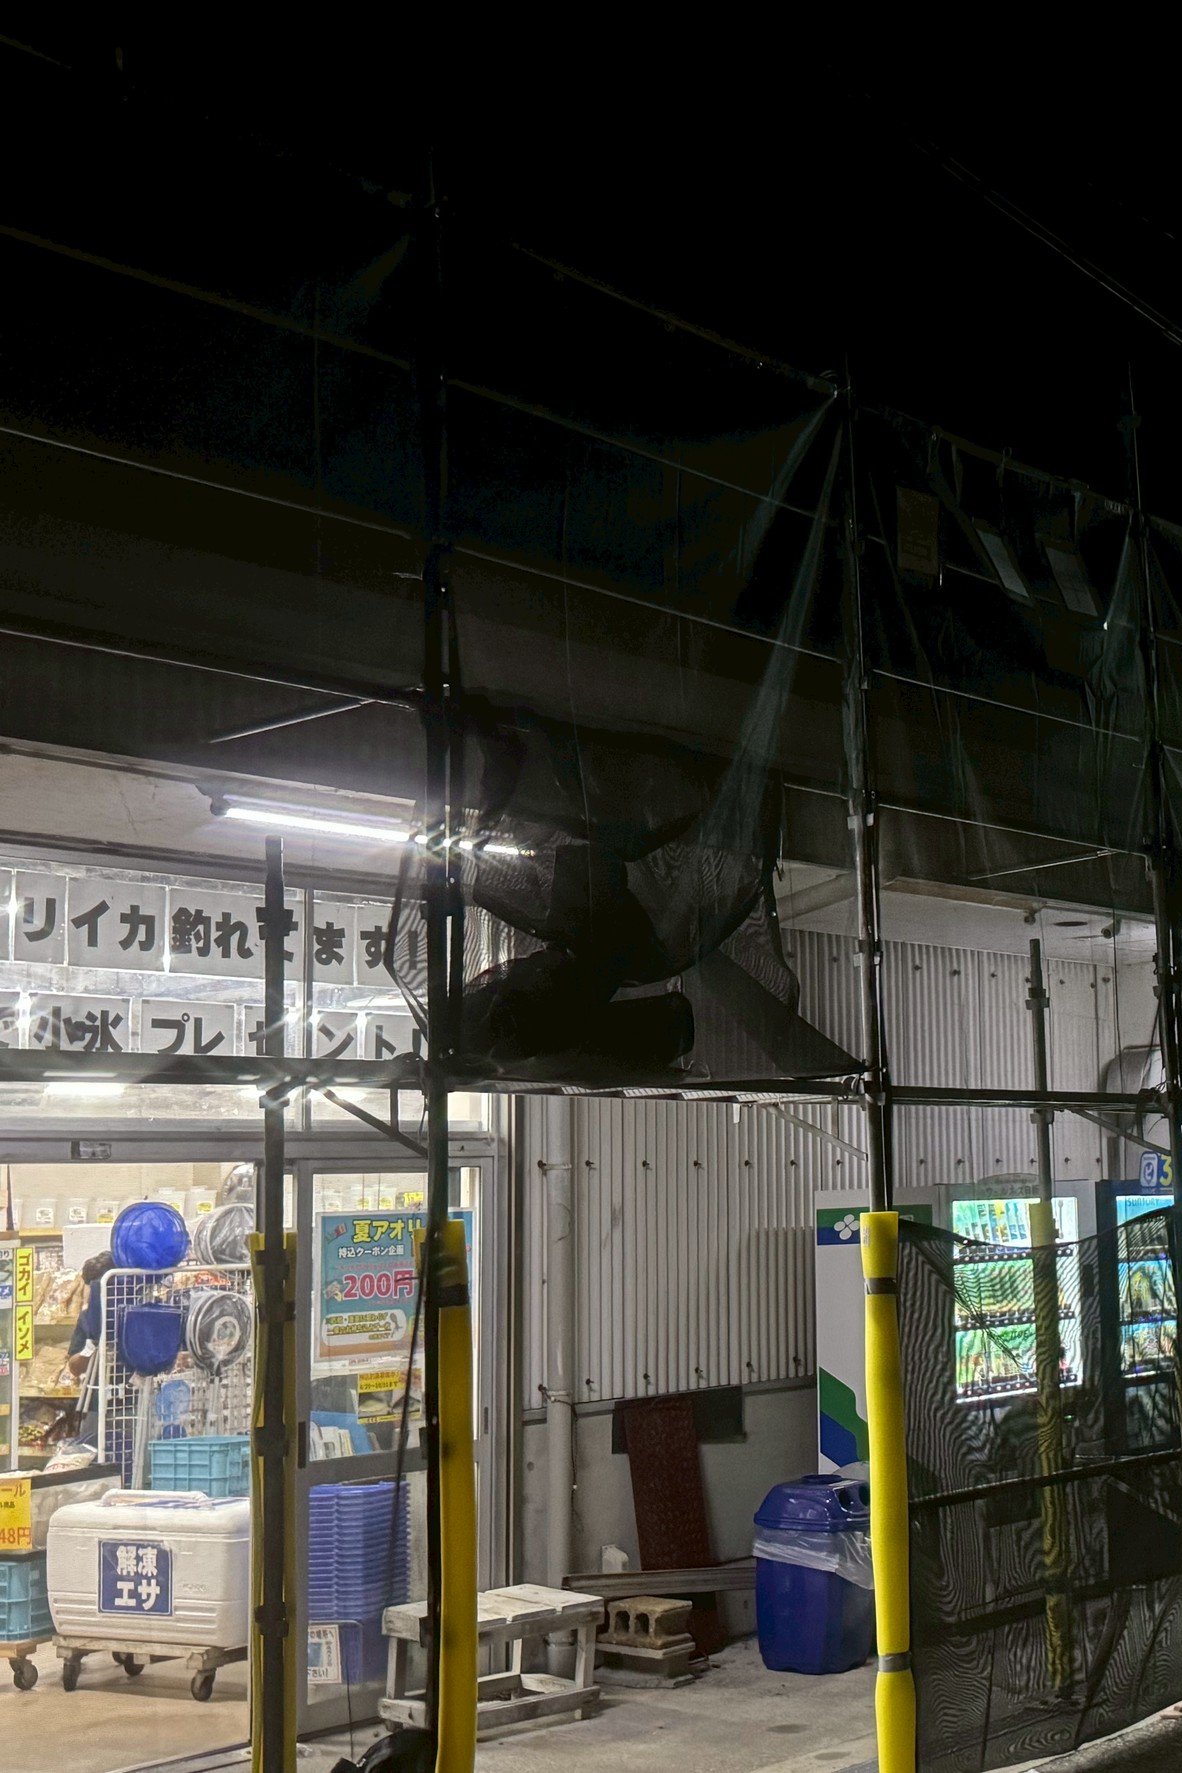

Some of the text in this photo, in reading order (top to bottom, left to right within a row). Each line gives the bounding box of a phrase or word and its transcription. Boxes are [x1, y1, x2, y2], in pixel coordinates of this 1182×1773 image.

[338, 1244, 405, 1259] 持込クーポン企画
[18, 1253, 31, 1296] ゴカイ
[343, 1269, 415, 1300] 200円
[17, 1311, 30, 1354] イソメ
[116, 1545, 158, 1577] 解凍
[114, 1578, 161, 1611] エサ
